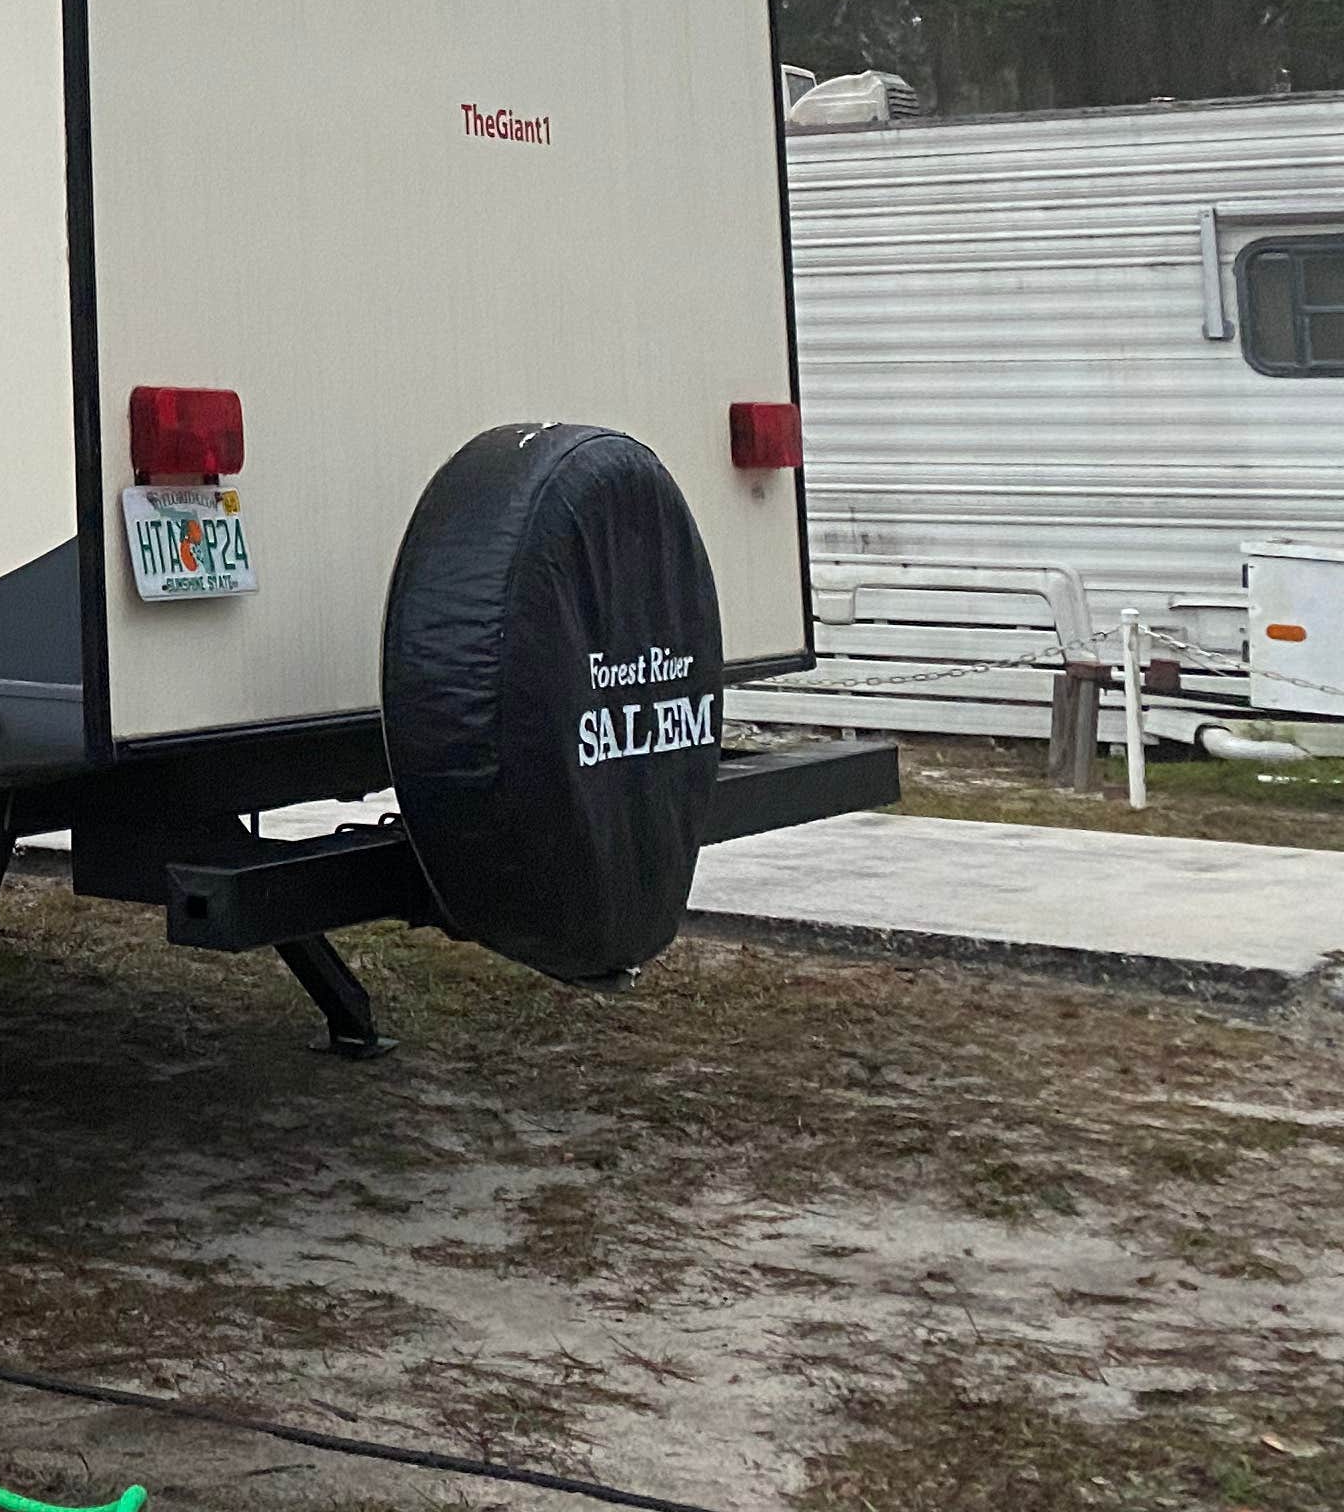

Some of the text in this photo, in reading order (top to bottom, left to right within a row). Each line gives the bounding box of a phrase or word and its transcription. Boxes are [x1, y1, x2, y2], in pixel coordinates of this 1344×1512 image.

[460, 103, 551, 145] TheGiant1
[202, 518, 249, 573] P24
[589, 646, 694, 689] Forest River
[578, 693, 715, 767] SALEM
